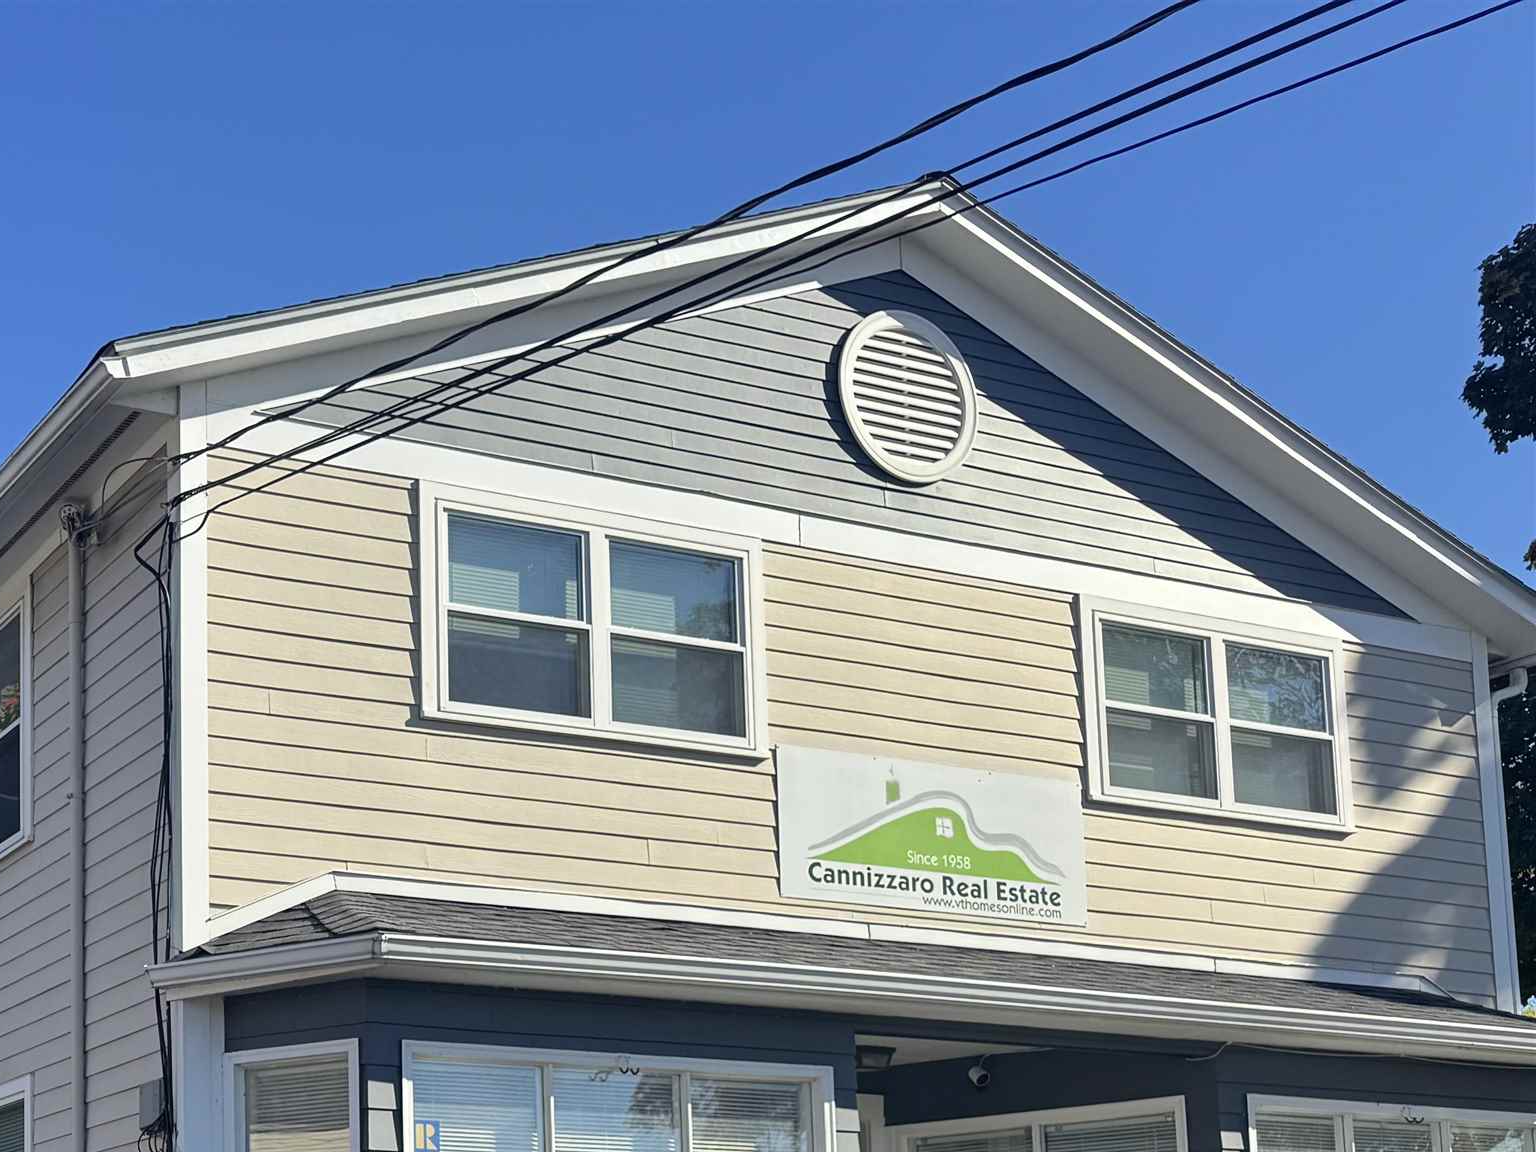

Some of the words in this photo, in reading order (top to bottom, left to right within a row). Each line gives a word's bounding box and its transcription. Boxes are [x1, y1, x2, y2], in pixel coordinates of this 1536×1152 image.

[907, 849, 939, 866] Since
[942, 854, 972, 870] 1958
[807, 861, 935, 894] Cannizzaro
[942, 875, 988, 900] Real
[995, 881, 1062, 907] Estate
[922, 895, 1063, 919] www.vthomesonline.com
